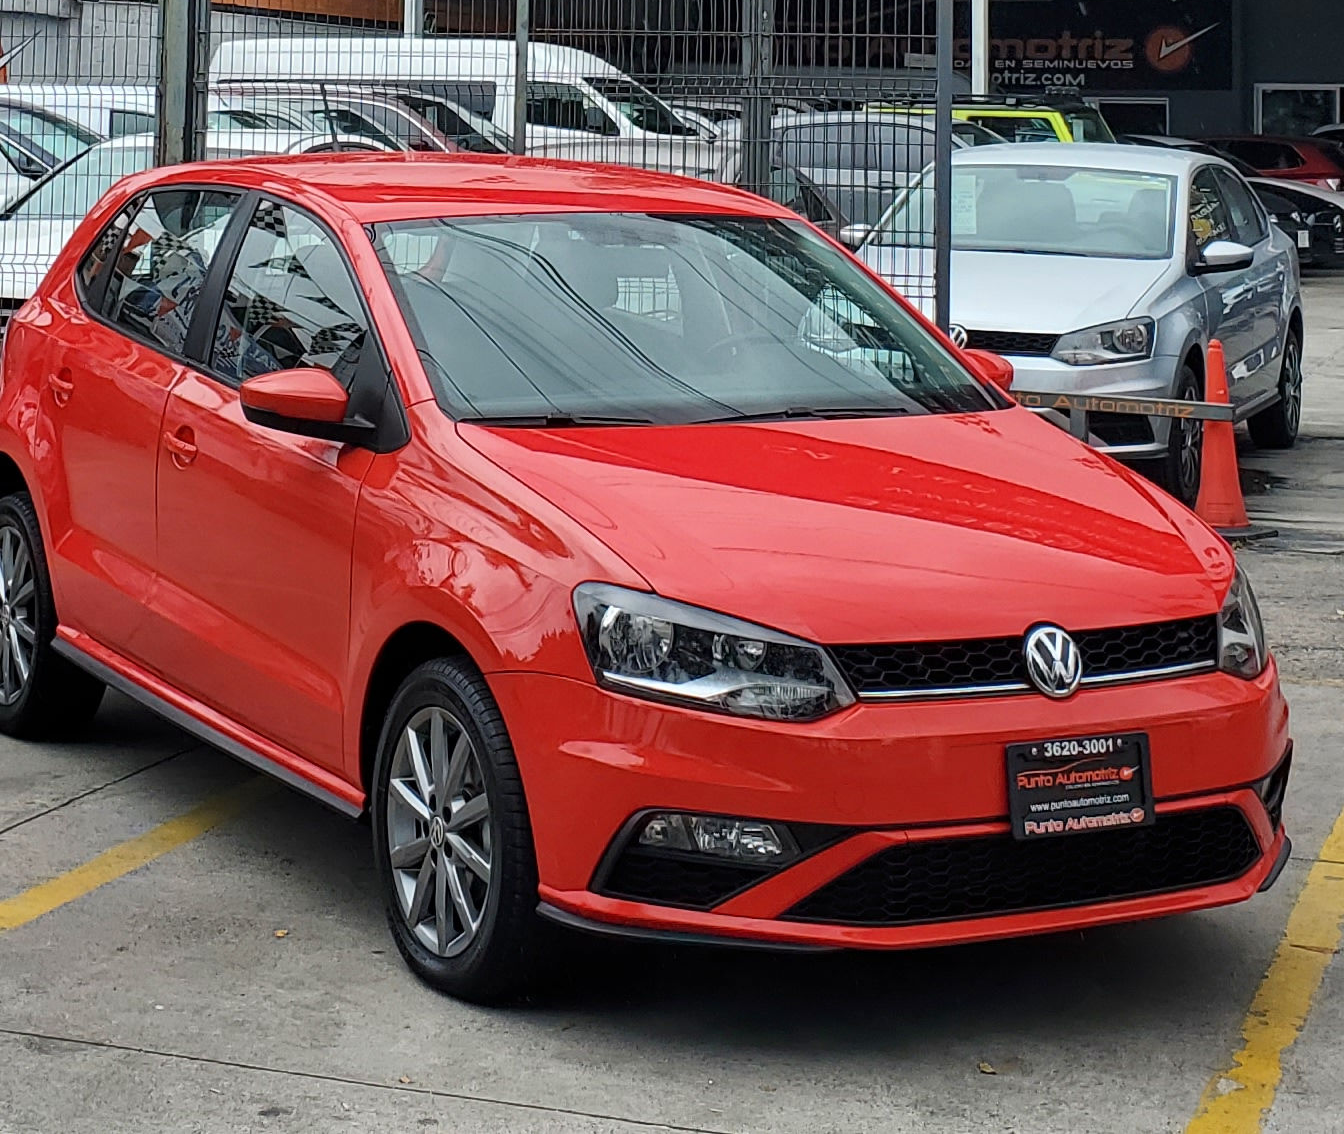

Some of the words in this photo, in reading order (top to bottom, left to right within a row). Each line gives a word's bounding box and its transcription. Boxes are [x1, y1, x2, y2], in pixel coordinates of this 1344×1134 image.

[994, 59, 1017, 69] EN
[1022, 58, 1135, 70] SEMINUEVOS
[1053, 394, 1195, 419] Automotriz
[1043, 738, 1114, 758] 3620-3001
[1017, 773, 1053, 790] Punto
[1055, 767, 1119, 786] Automotriz
[1029, 793, 1130, 813] www.puntoautomotriz.com
[1024, 818, 1064, 836] Punto
